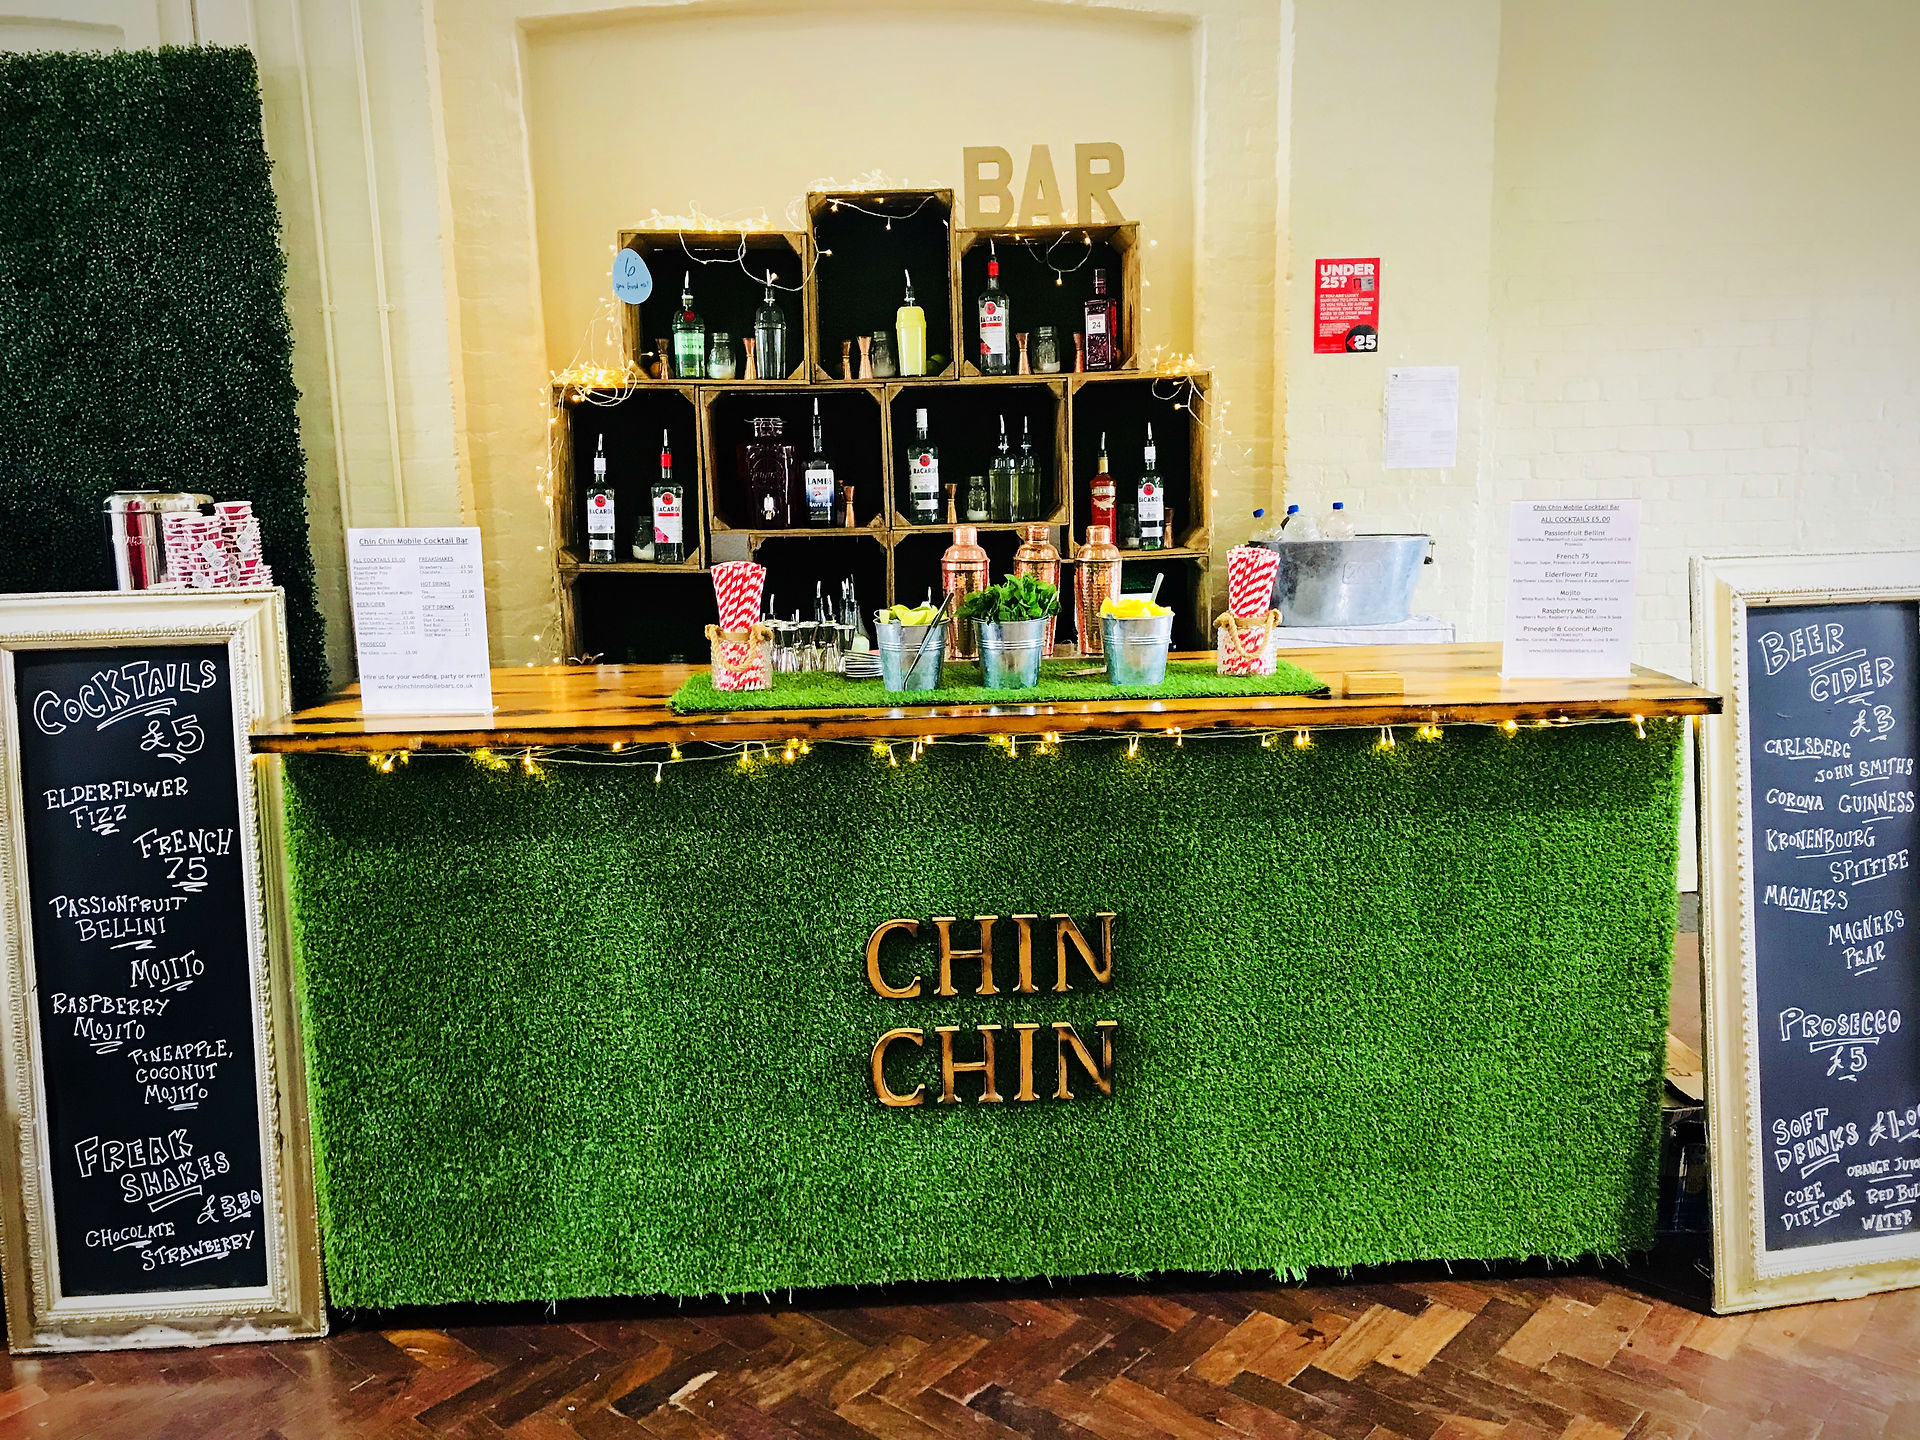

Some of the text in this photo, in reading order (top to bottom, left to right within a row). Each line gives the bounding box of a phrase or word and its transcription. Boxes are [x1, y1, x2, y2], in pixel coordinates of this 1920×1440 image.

[964, 142, 1126, 226] BAR
[1320, 264, 1374, 276] UNDER
[1320, 276, 1347, 288] 25?
[1354, 334, 1376, 349] 25
[1758, 623, 1844, 676] BEER
[1810, 657, 1895, 701] CIDER
[34, 660, 216, 734] COCKTAILS
[140, 714, 205, 753] £5
[1850, 705, 1896, 737] £3
[1765, 738, 1851, 758] CARLSBERG
[1815, 758, 1914, 783] JOHN SMITHS
[43, 777, 189, 810] ELDERFLOWER
[1766, 789, 1915, 814] CORONA GUINNESS
[70, 805, 127, 828] FIZZ
[133, 829, 233, 859] FRENCH
[1766, 826, 1875, 852] KRONENBOURG
[164, 857, 208, 880] 75
[1829, 849, 1909, 883] SPITFIRE
[49, 895, 187, 919] PASSIONFRUIT
[1764, 885, 1848, 911] MAGNERS
[75, 917, 166, 941] BELLINI
[1828, 910, 1905, 946] MAGNERS
[130, 950, 204, 988] MOJITO
[866, 912, 1117, 998] CHIN
[1842, 941, 1886, 970] PEAR
[51, 993, 170, 1016] RASPBERRY
[73, 1017, 145, 1040] MOJITO
[1780, 1007, 1901, 1041] PROSECCO
[128, 1040, 233, 1065] PINEAPPLE,
[870, 1020, 1118, 1107] CHIN
[1827, 1046, 1867, 1076] £5
[136, 1063, 218, 1083] COCONUT
[144, 1083, 208, 1105] MOJITO
[1772, 1108, 1829, 1145] SOFT
[75, 1129, 193, 1178] FREAK
[1774, 1122, 1860, 1173] DRINKS
[120, 1151, 230, 1202] SHAKES
[1847, 1159, 1890, 1177] ORANGE
[1784, 1181, 1825, 1206] COKE
[1866, 1188, 1894, 1204] RED
[1781, 1189, 1855, 1230] DIET COKE
[1862, 1209, 1912, 1230] WATER
[86, 1222, 175, 1247] CHOCOLATE
[141, 1230, 255, 1270] STRAWBERRY
